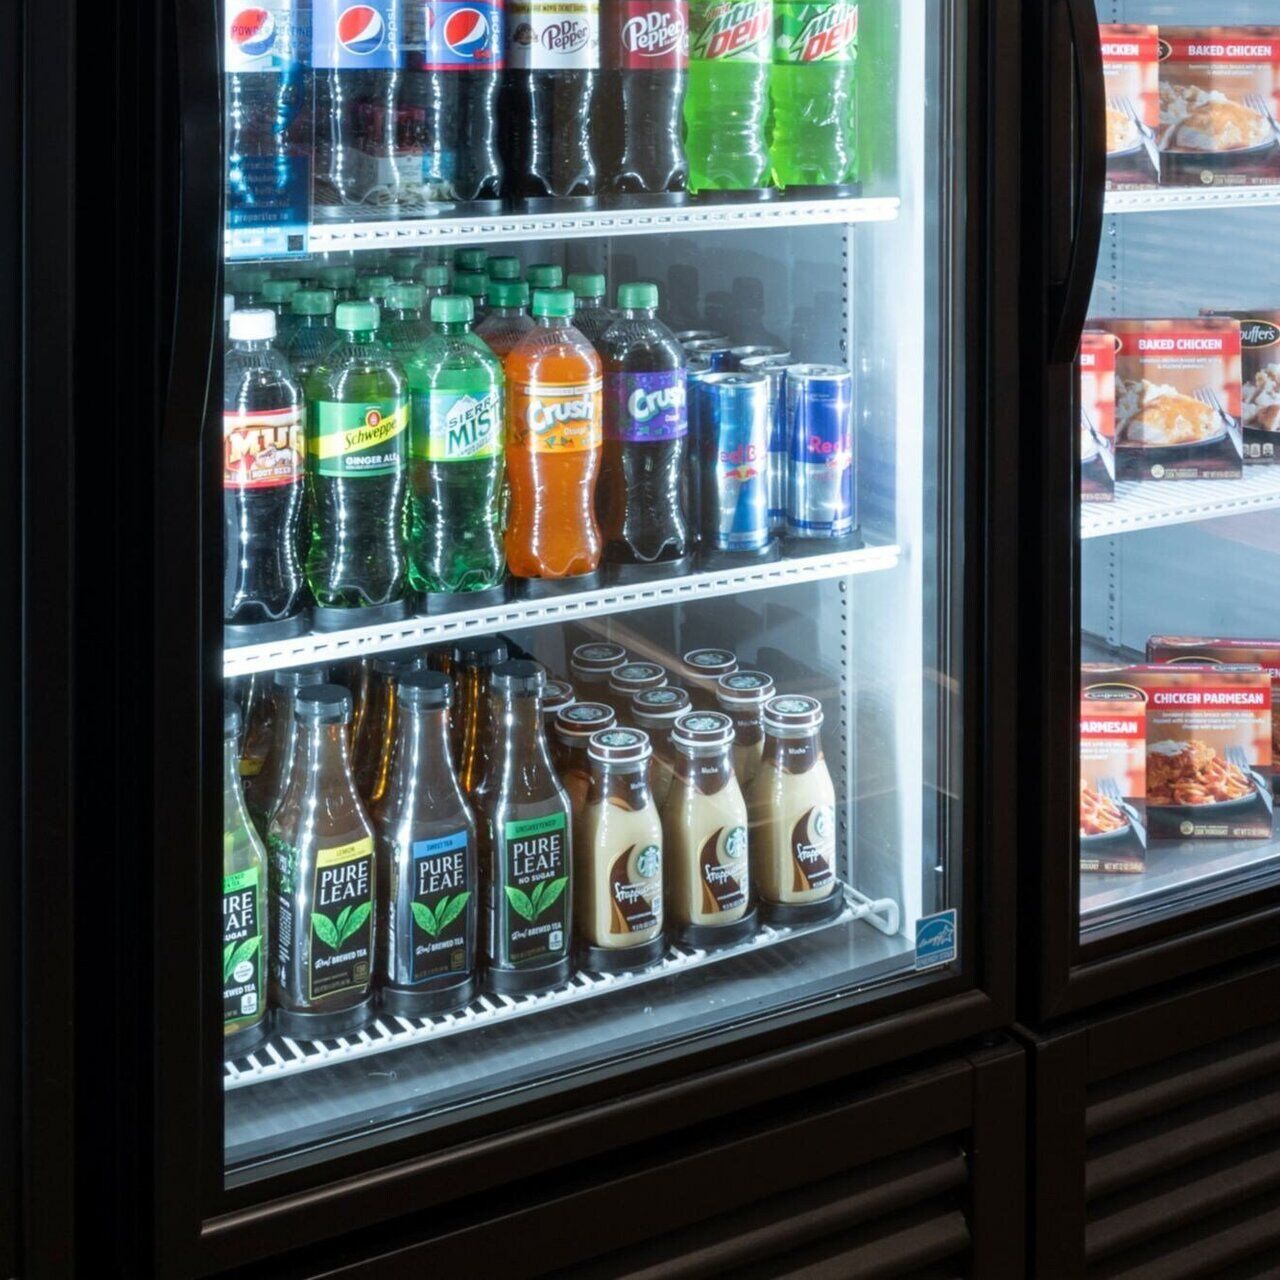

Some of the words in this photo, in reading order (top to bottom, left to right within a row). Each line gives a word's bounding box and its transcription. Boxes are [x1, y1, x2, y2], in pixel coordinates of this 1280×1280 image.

[561, 20, 579, 35] Dr
[647, 11, 671, 29] Dr
[547, 24, 589, 50] Pepper
[629, 15, 683, 54] Pepper
[1188, 45, 1223, 57] BAKED
[1226, 45, 1272, 57] CHICKEN
[1138, 339, 1175, 351] BAKED
[1177, 339, 1222, 350] CHICKEN
[527, 396, 595, 431] Crush
[345, 454, 380, 466] GINGER
[1154, 692, 1200, 705] CHICKEN
[1202, 693, 1264, 705] PARMESAN
[513, 834, 560, 861] PURE
[321, 861, 368, 889] PURE
[420, 853, 464, 879] PURE
